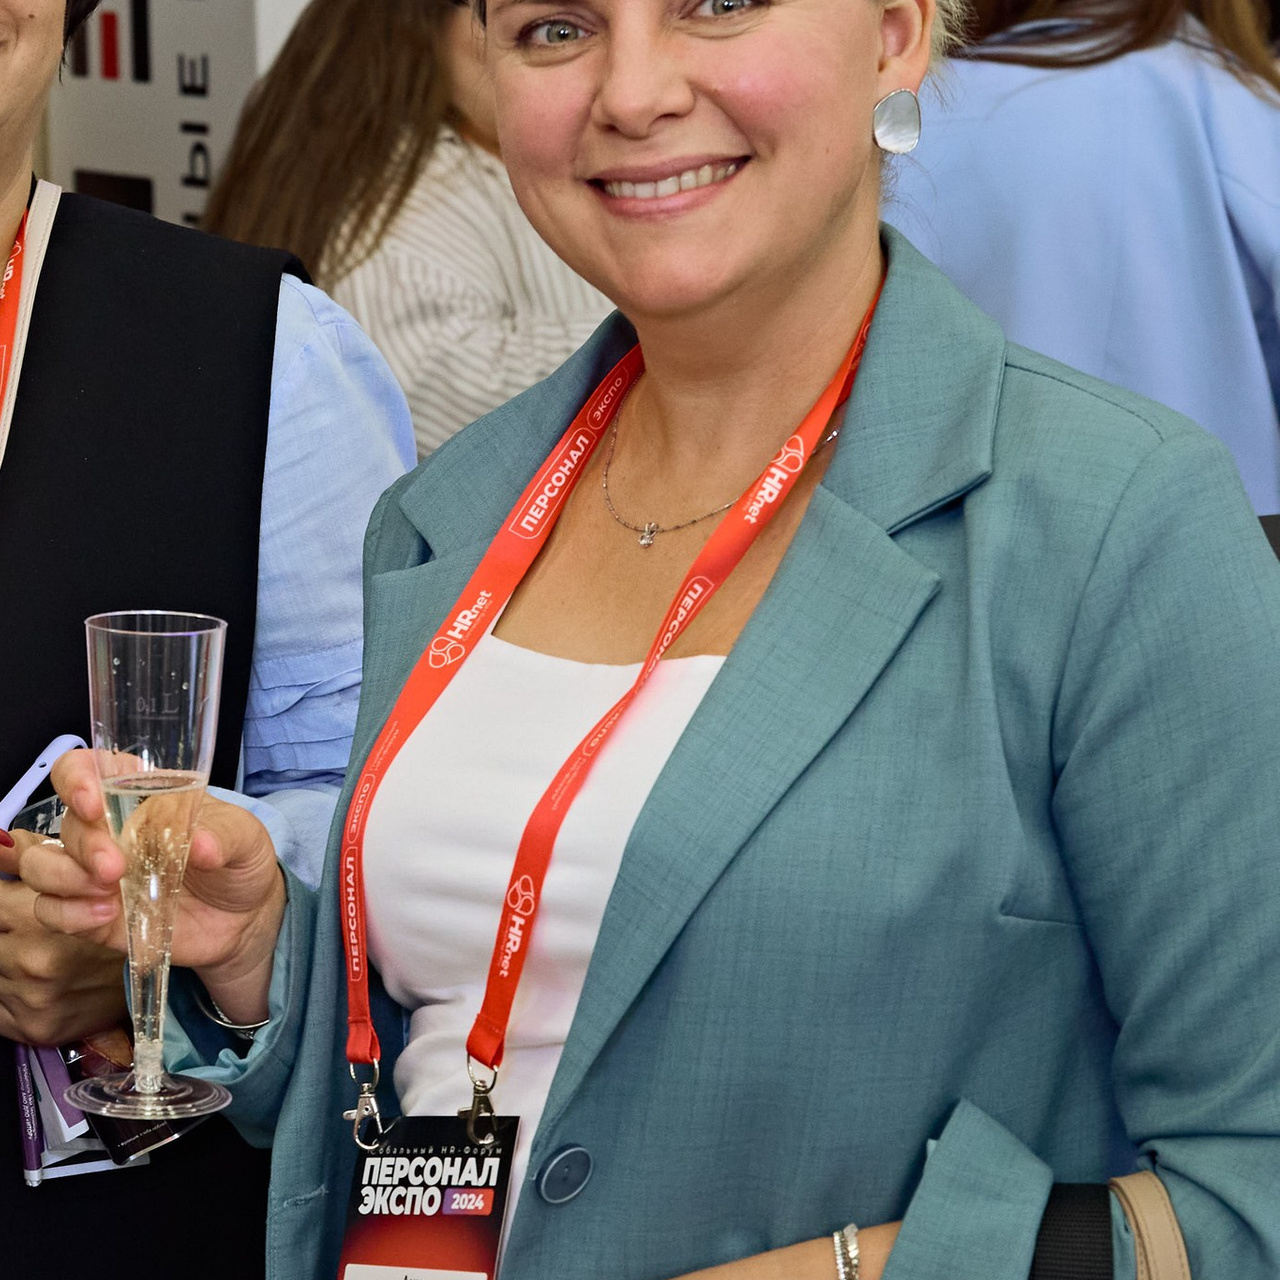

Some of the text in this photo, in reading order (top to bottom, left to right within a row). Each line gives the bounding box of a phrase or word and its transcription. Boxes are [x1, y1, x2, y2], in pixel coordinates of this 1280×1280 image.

[593, 376, 623, 422] ЭКСПО
[520, 434, 590, 533] ПЕРСОНАЛ
[744, 467, 788, 524] HRnet
[446, 590, 492, 640] HRnet
[350, 782, 371, 833] ЭКСПО
[346, 856, 360, 972] ПЕРСОНАЛ
[499, 914, 525, 978] HRnet
[362, 1157, 501, 1186] ПЕРСОНАЛ
[440, 1145, 503, 1157] HR-Форум
[358, 1186, 485, 1217] ЭКСПО 2024
